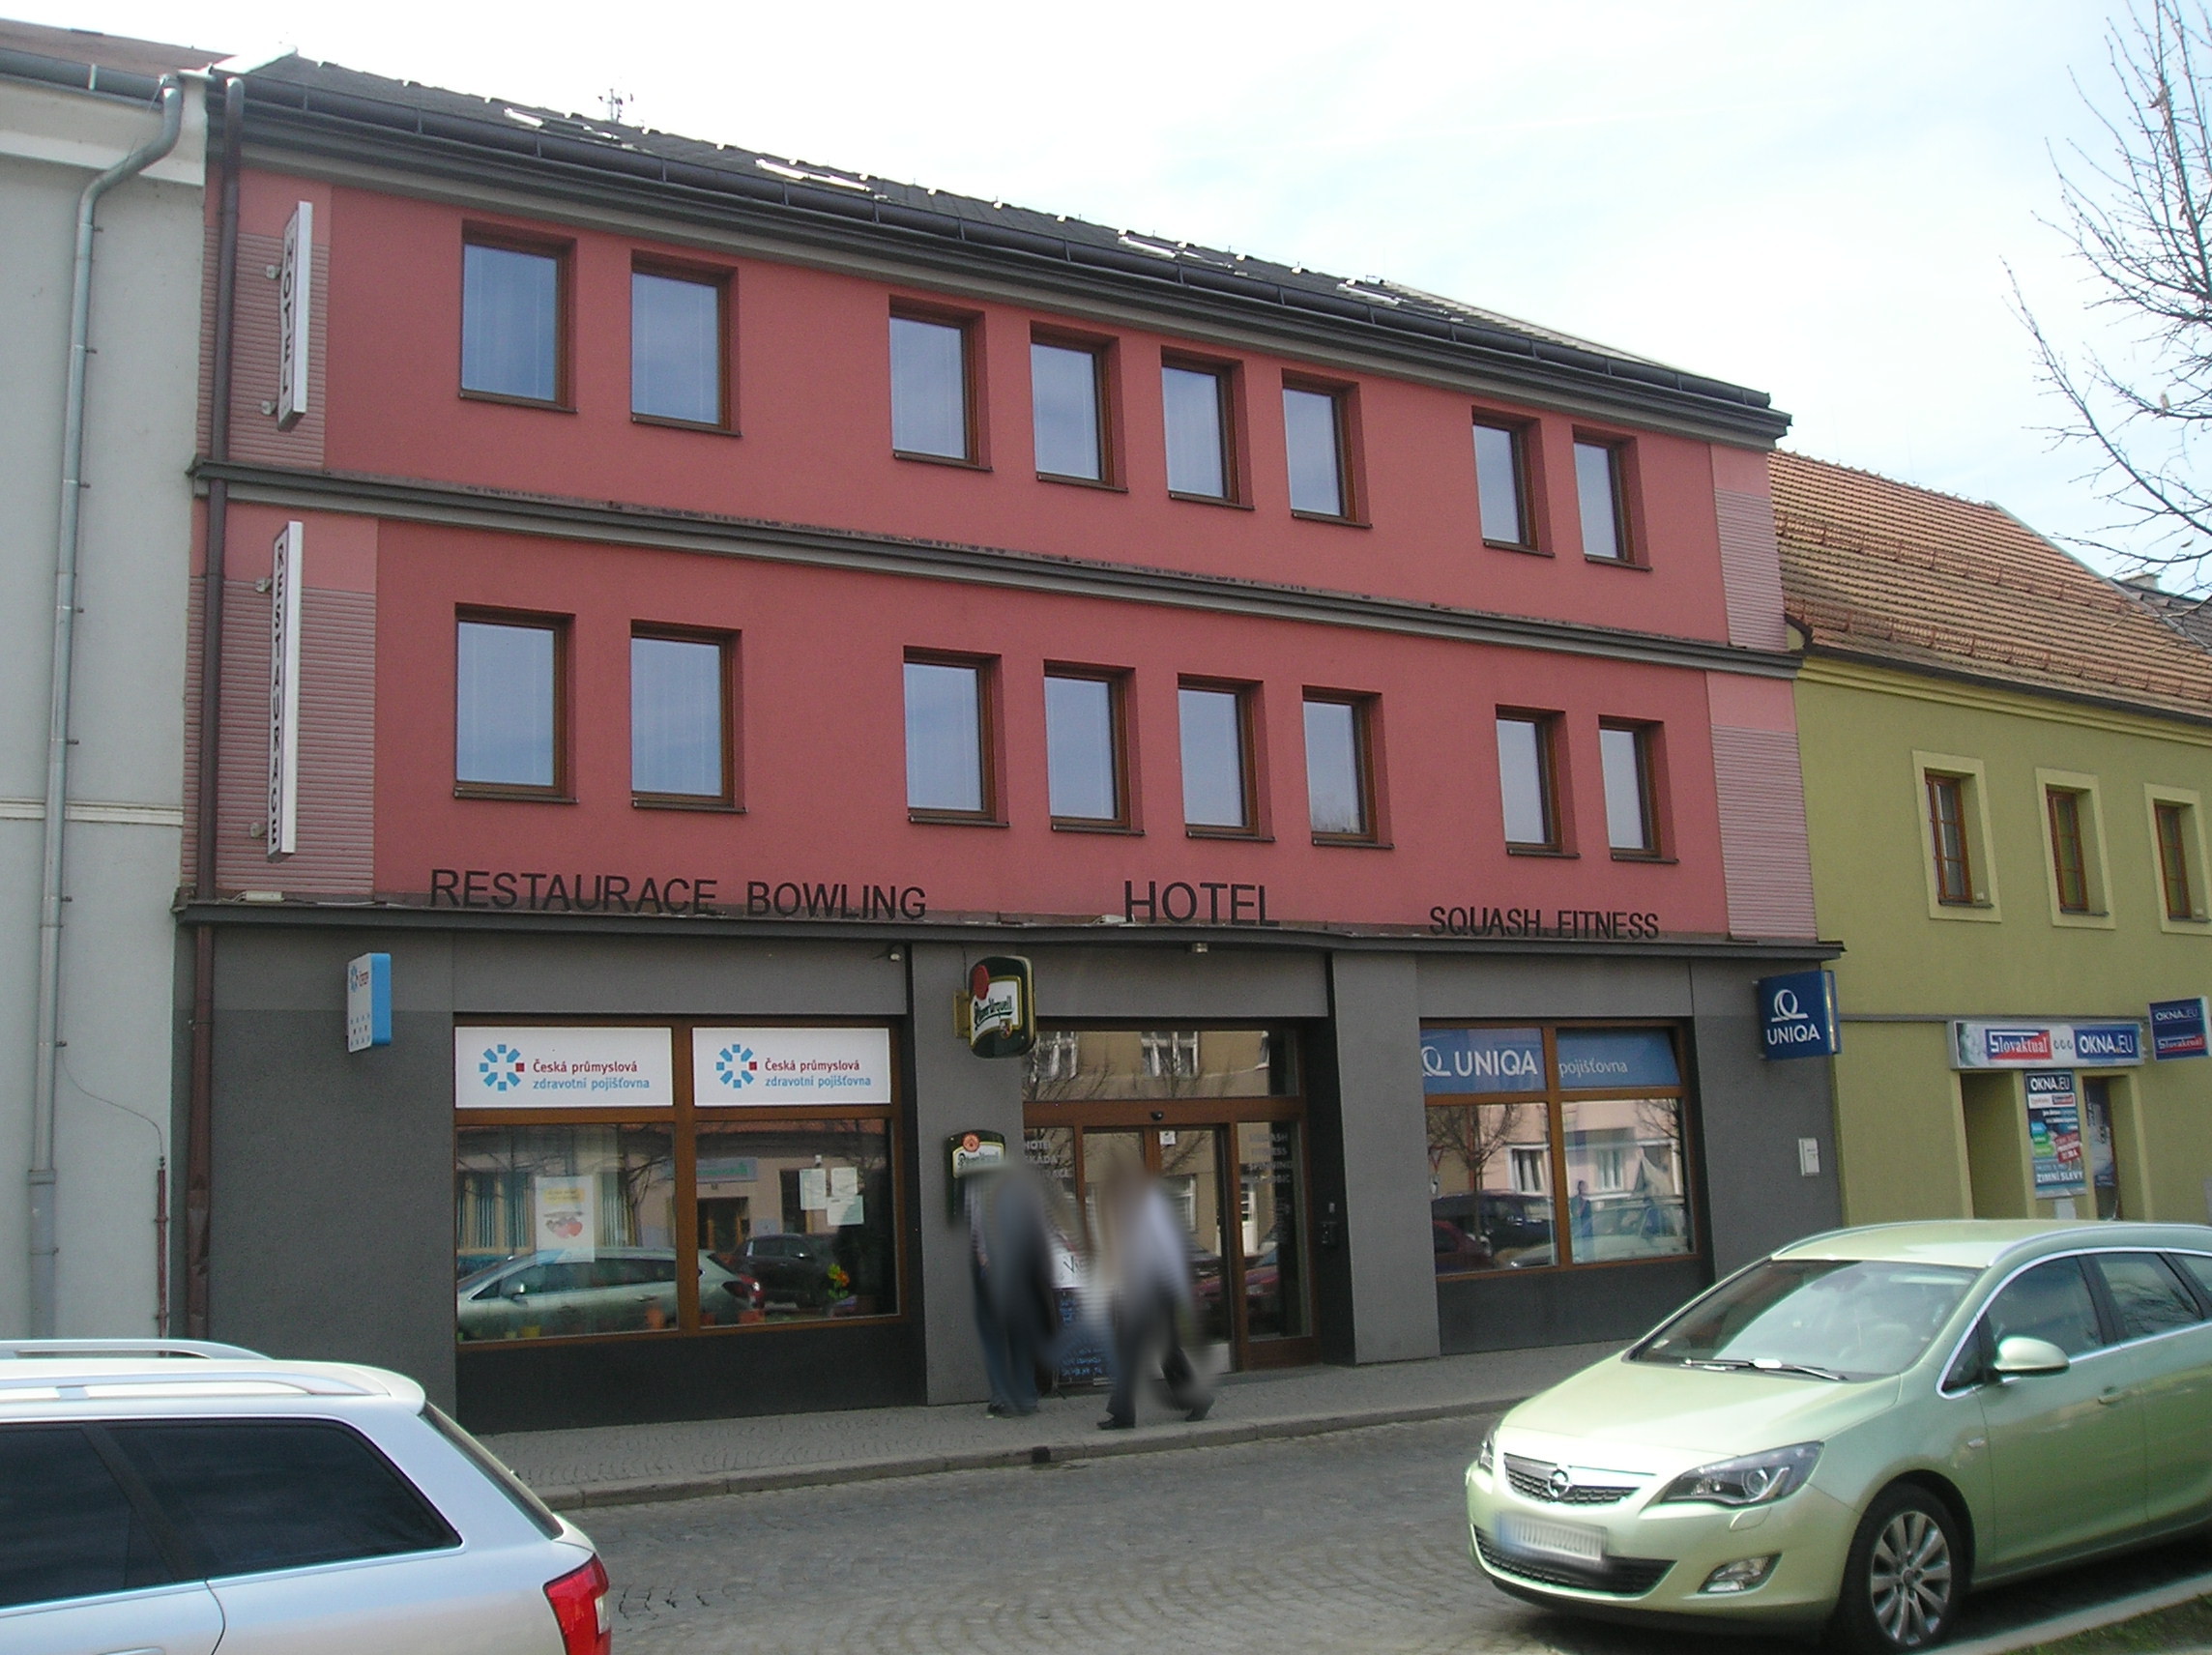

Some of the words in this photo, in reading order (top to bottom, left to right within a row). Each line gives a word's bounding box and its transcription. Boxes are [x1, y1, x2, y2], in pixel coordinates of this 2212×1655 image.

[282, 238, 294, 393] HOTEL
[271, 542, 284, 845] RESTAURACE
[429, 868, 718, 916] RESTAURACE
[746, 880, 927, 921] BOWLING
[1124, 880, 1279, 927] HOTEL
[1429, 906, 1541, 937] SQUASH
[1557, 910, 1659, 940] FITNESS
[1766, 1024, 1821, 1045] UNIQA
[1989, 1031, 2049, 1054] Slovaktual
[2080, 1034, 2133, 1054] OKNA.EU
[533, 1060, 568, 1073] Česká
[571, 1060, 638, 1074] průmyslová
[765, 1060, 796, 1071] Česká
[800, 1060, 860, 1073] průmyslová
[1455, 1049, 1538, 1077] UNIQA
[533, 1076, 587, 1089] zdravotní
[591, 1076, 650, 1090] pojišťovna
[765, 1075, 814, 1087] zdravotní
[817, 1075, 872, 1089] pojišťovna
